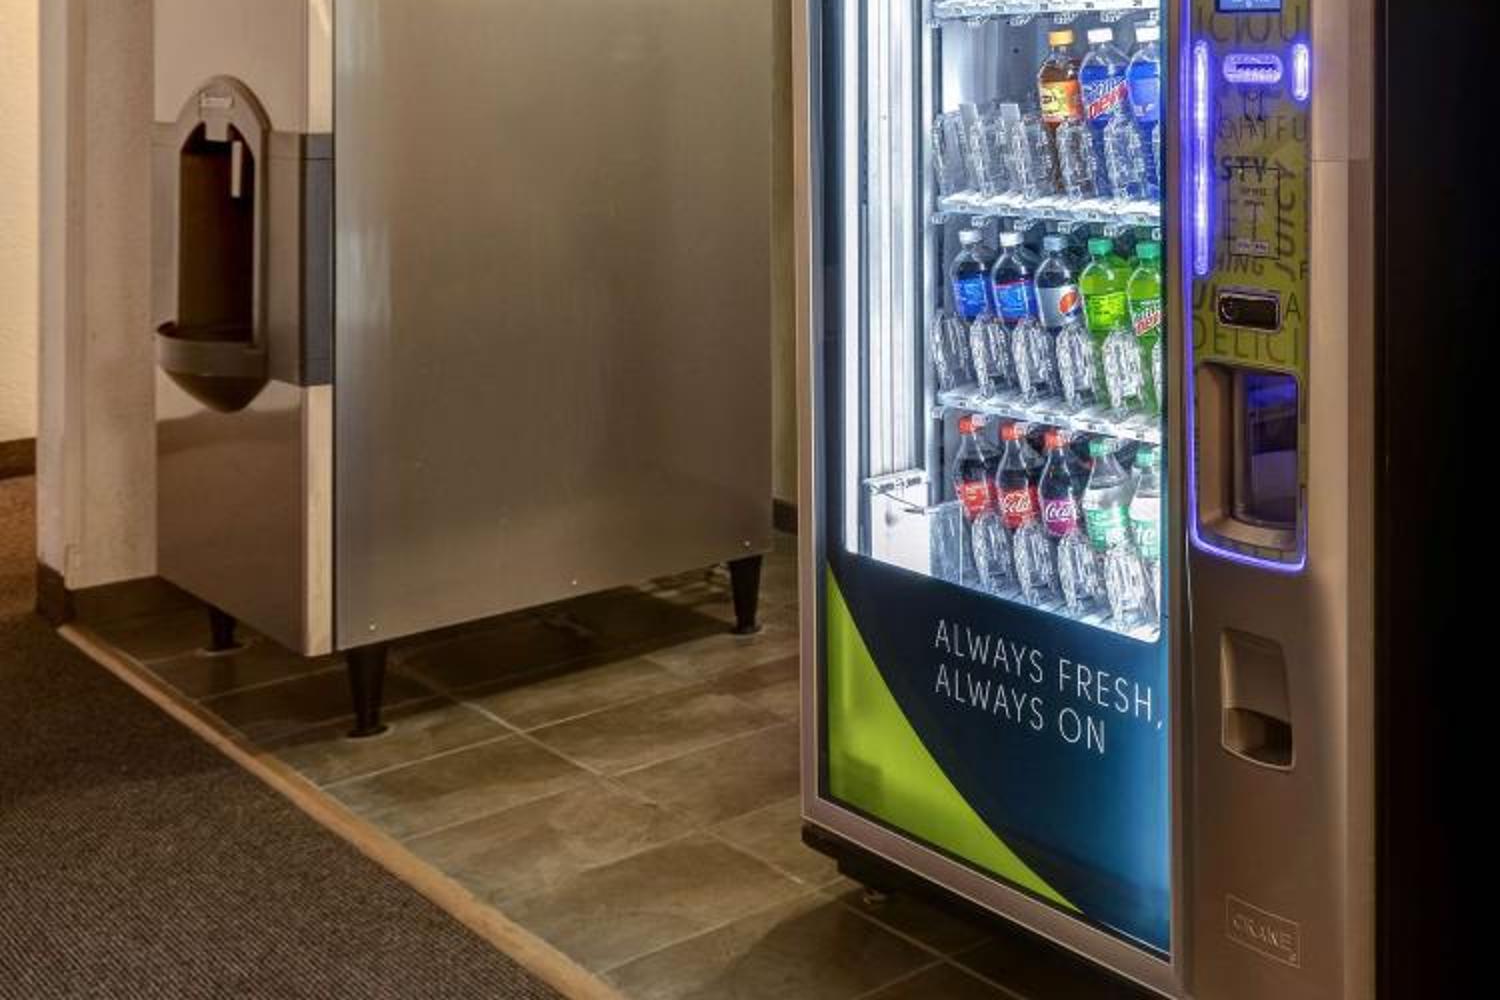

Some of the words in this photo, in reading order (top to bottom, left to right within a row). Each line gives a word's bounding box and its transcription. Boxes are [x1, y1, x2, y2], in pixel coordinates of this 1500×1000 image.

[935, 619, 1044, 684] ALWAYS
[1058, 659, 1162, 730] FRESH,
[935, 664, 1045, 732] ALWAYS
[1058, 707, 1105, 755] ON
